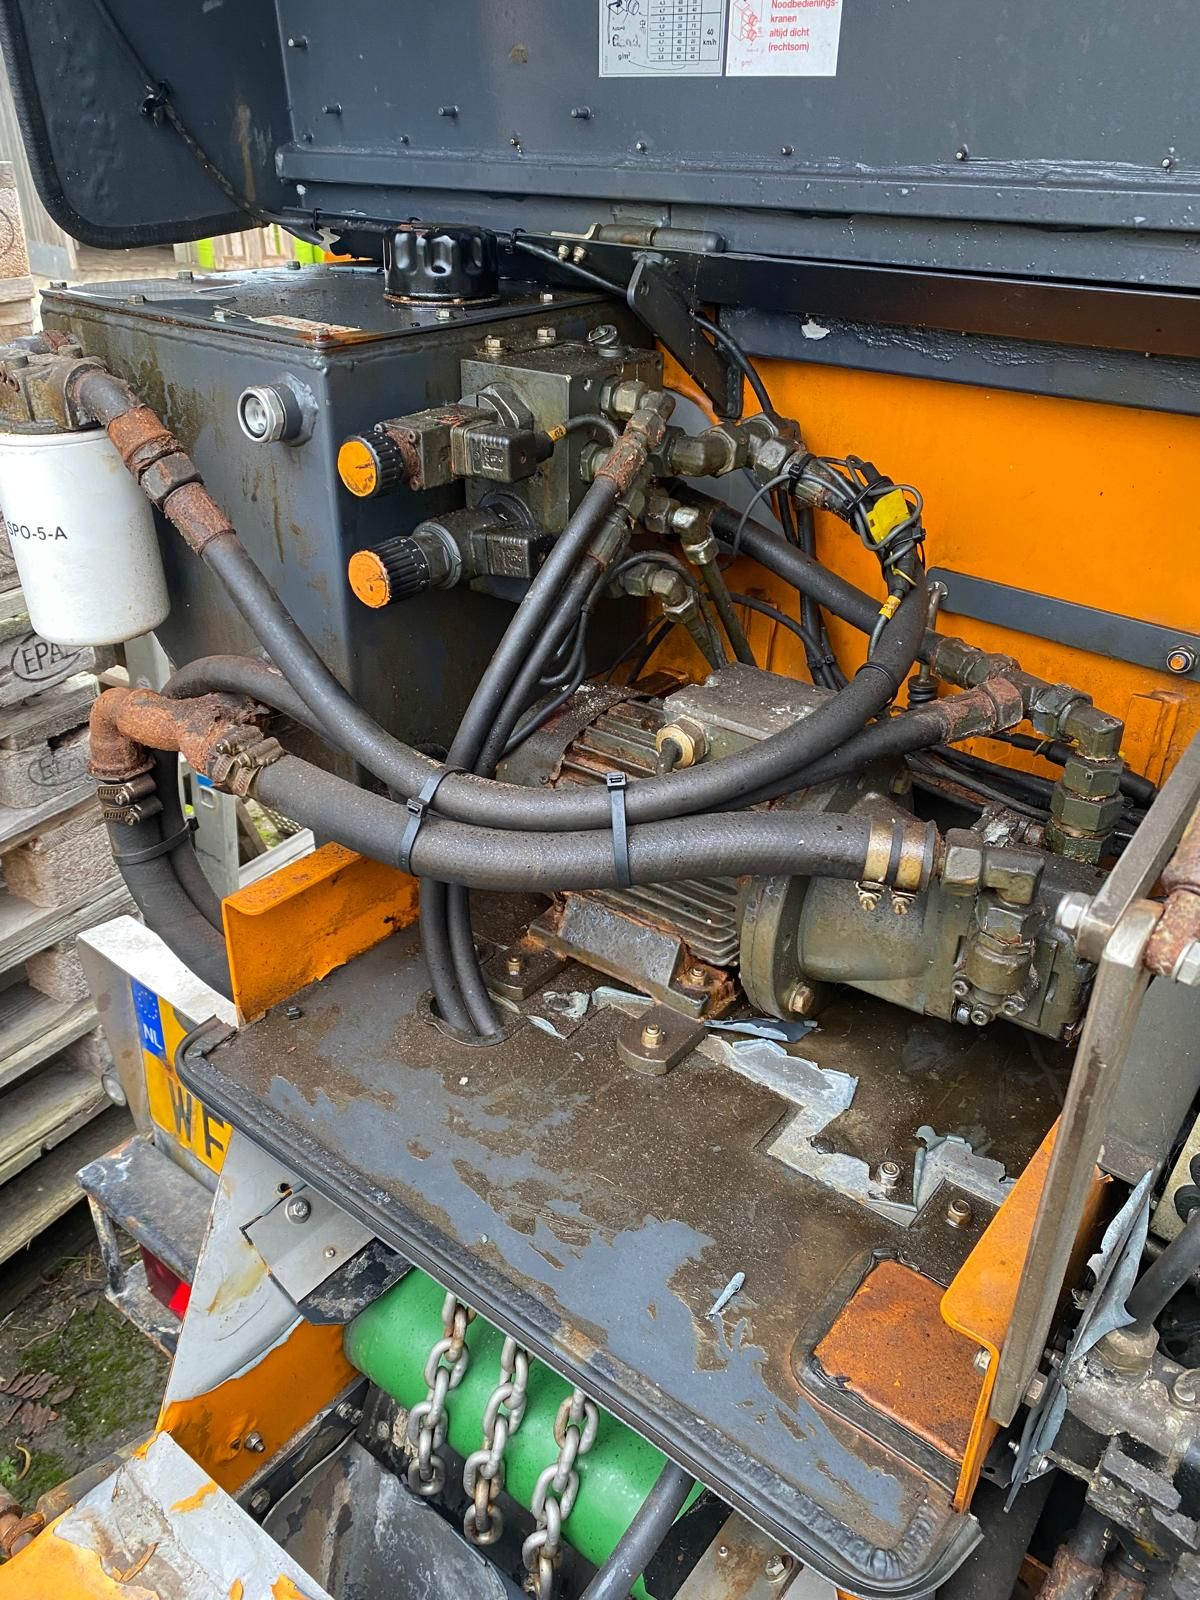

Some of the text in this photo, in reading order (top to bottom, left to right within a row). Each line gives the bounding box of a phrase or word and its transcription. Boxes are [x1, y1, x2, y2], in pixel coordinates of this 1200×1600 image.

[772, 0, 838, 9] Noodbedienings-
[770, 14, 797, 23] kranen
[769, 28, 809, 38] altijd dicht
[703, 38, 717, 46] km/h
[768, 42, 810, 53] (rechtsom)
[7, 521, 68, 541] SPO-5-A
[143, 1023, 164, 1051] NL
